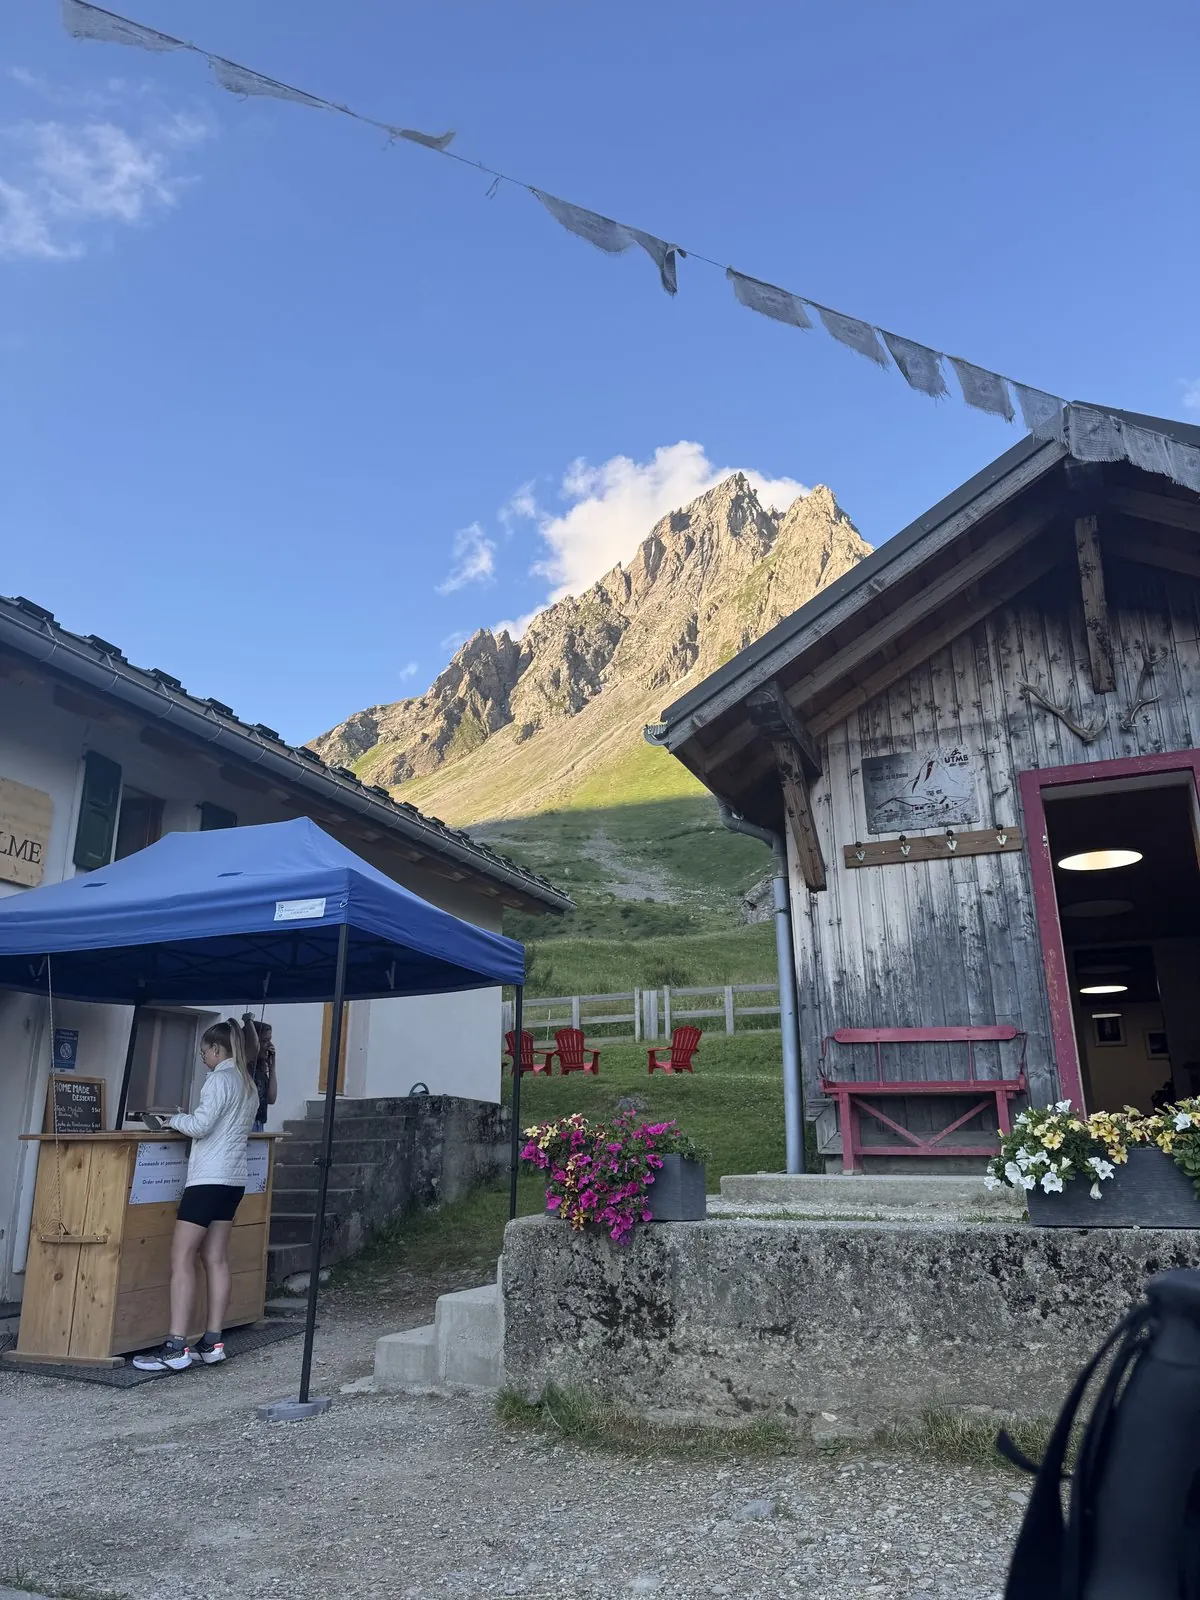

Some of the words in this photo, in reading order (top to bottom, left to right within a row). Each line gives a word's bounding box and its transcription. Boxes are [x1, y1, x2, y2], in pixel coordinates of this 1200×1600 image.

[944, 754, 969, 764] UTMB
[72, 1084, 90, 1095] MADE
[72, 1093, 97, 1102] DESSERTS
